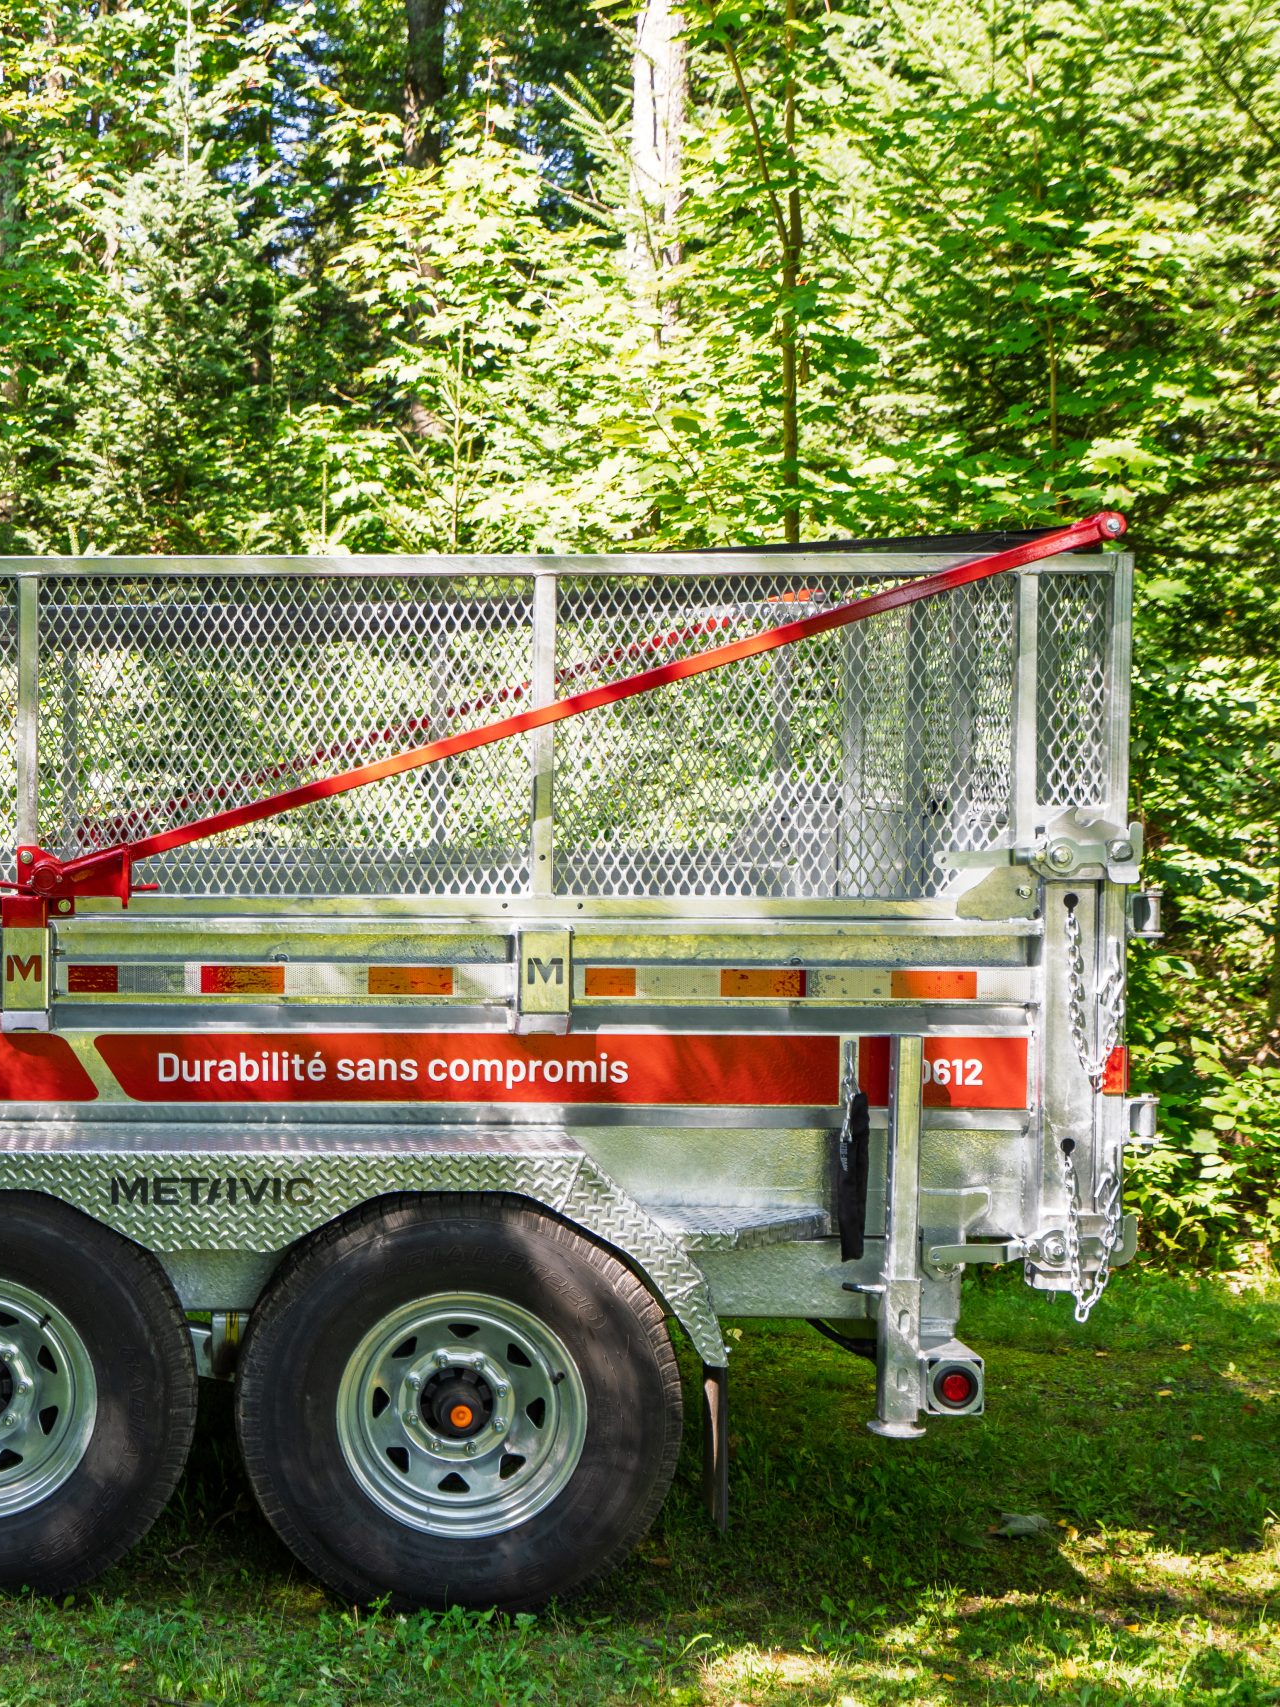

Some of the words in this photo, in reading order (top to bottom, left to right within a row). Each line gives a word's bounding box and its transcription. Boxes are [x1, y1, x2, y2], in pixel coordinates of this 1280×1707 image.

[157, 1051, 326, 1083] Durabilité
[336, 1057, 419, 1082] sans
[428, 1053, 630, 1089] compromis
[111, 1177, 316, 1207] METAVIC
